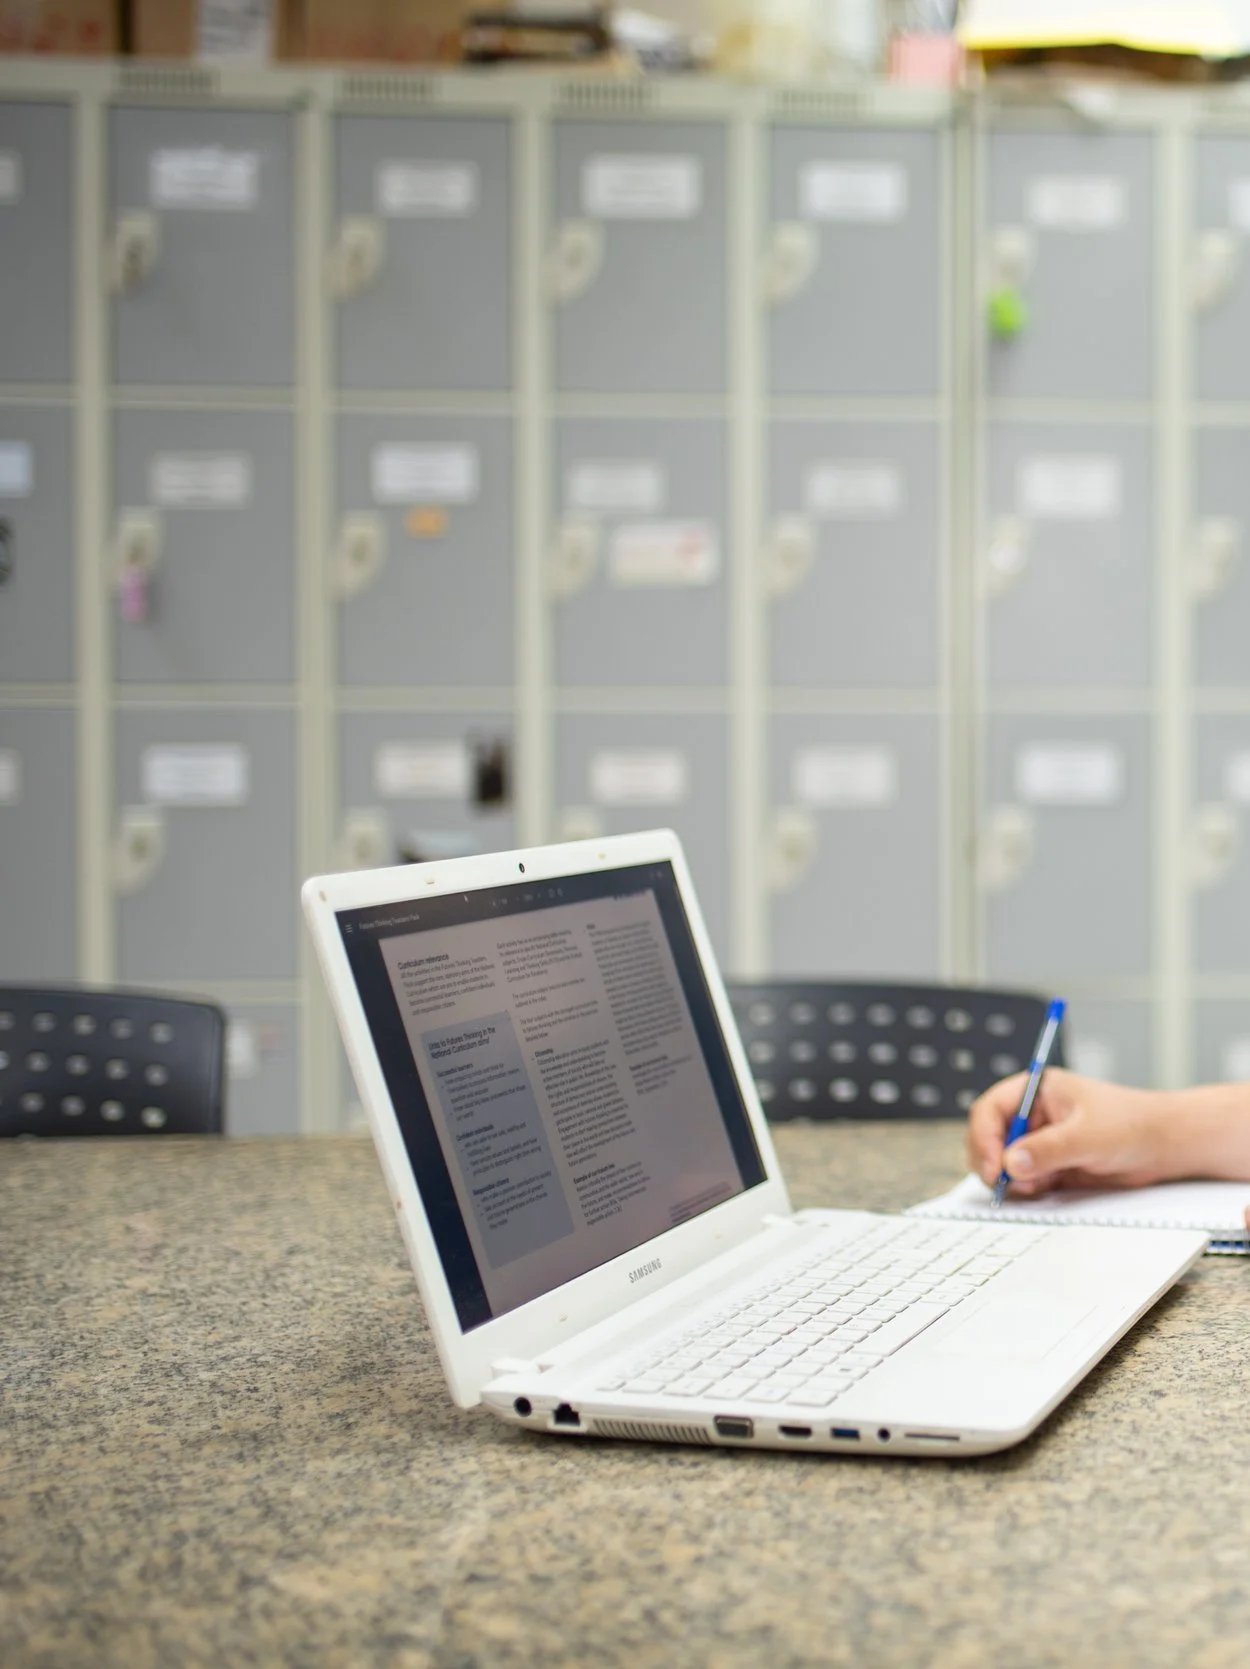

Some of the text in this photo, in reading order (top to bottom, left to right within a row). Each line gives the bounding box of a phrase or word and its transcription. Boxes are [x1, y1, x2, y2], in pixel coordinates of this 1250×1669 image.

[396, 957, 425, 970] Curriculum
[445, 1034, 463, 1045] Futures
[430, 1047, 451, 1059] National
[451, 1040, 477, 1053] Curriculum
[629, 1258, 662, 1283] SAMSUNG
